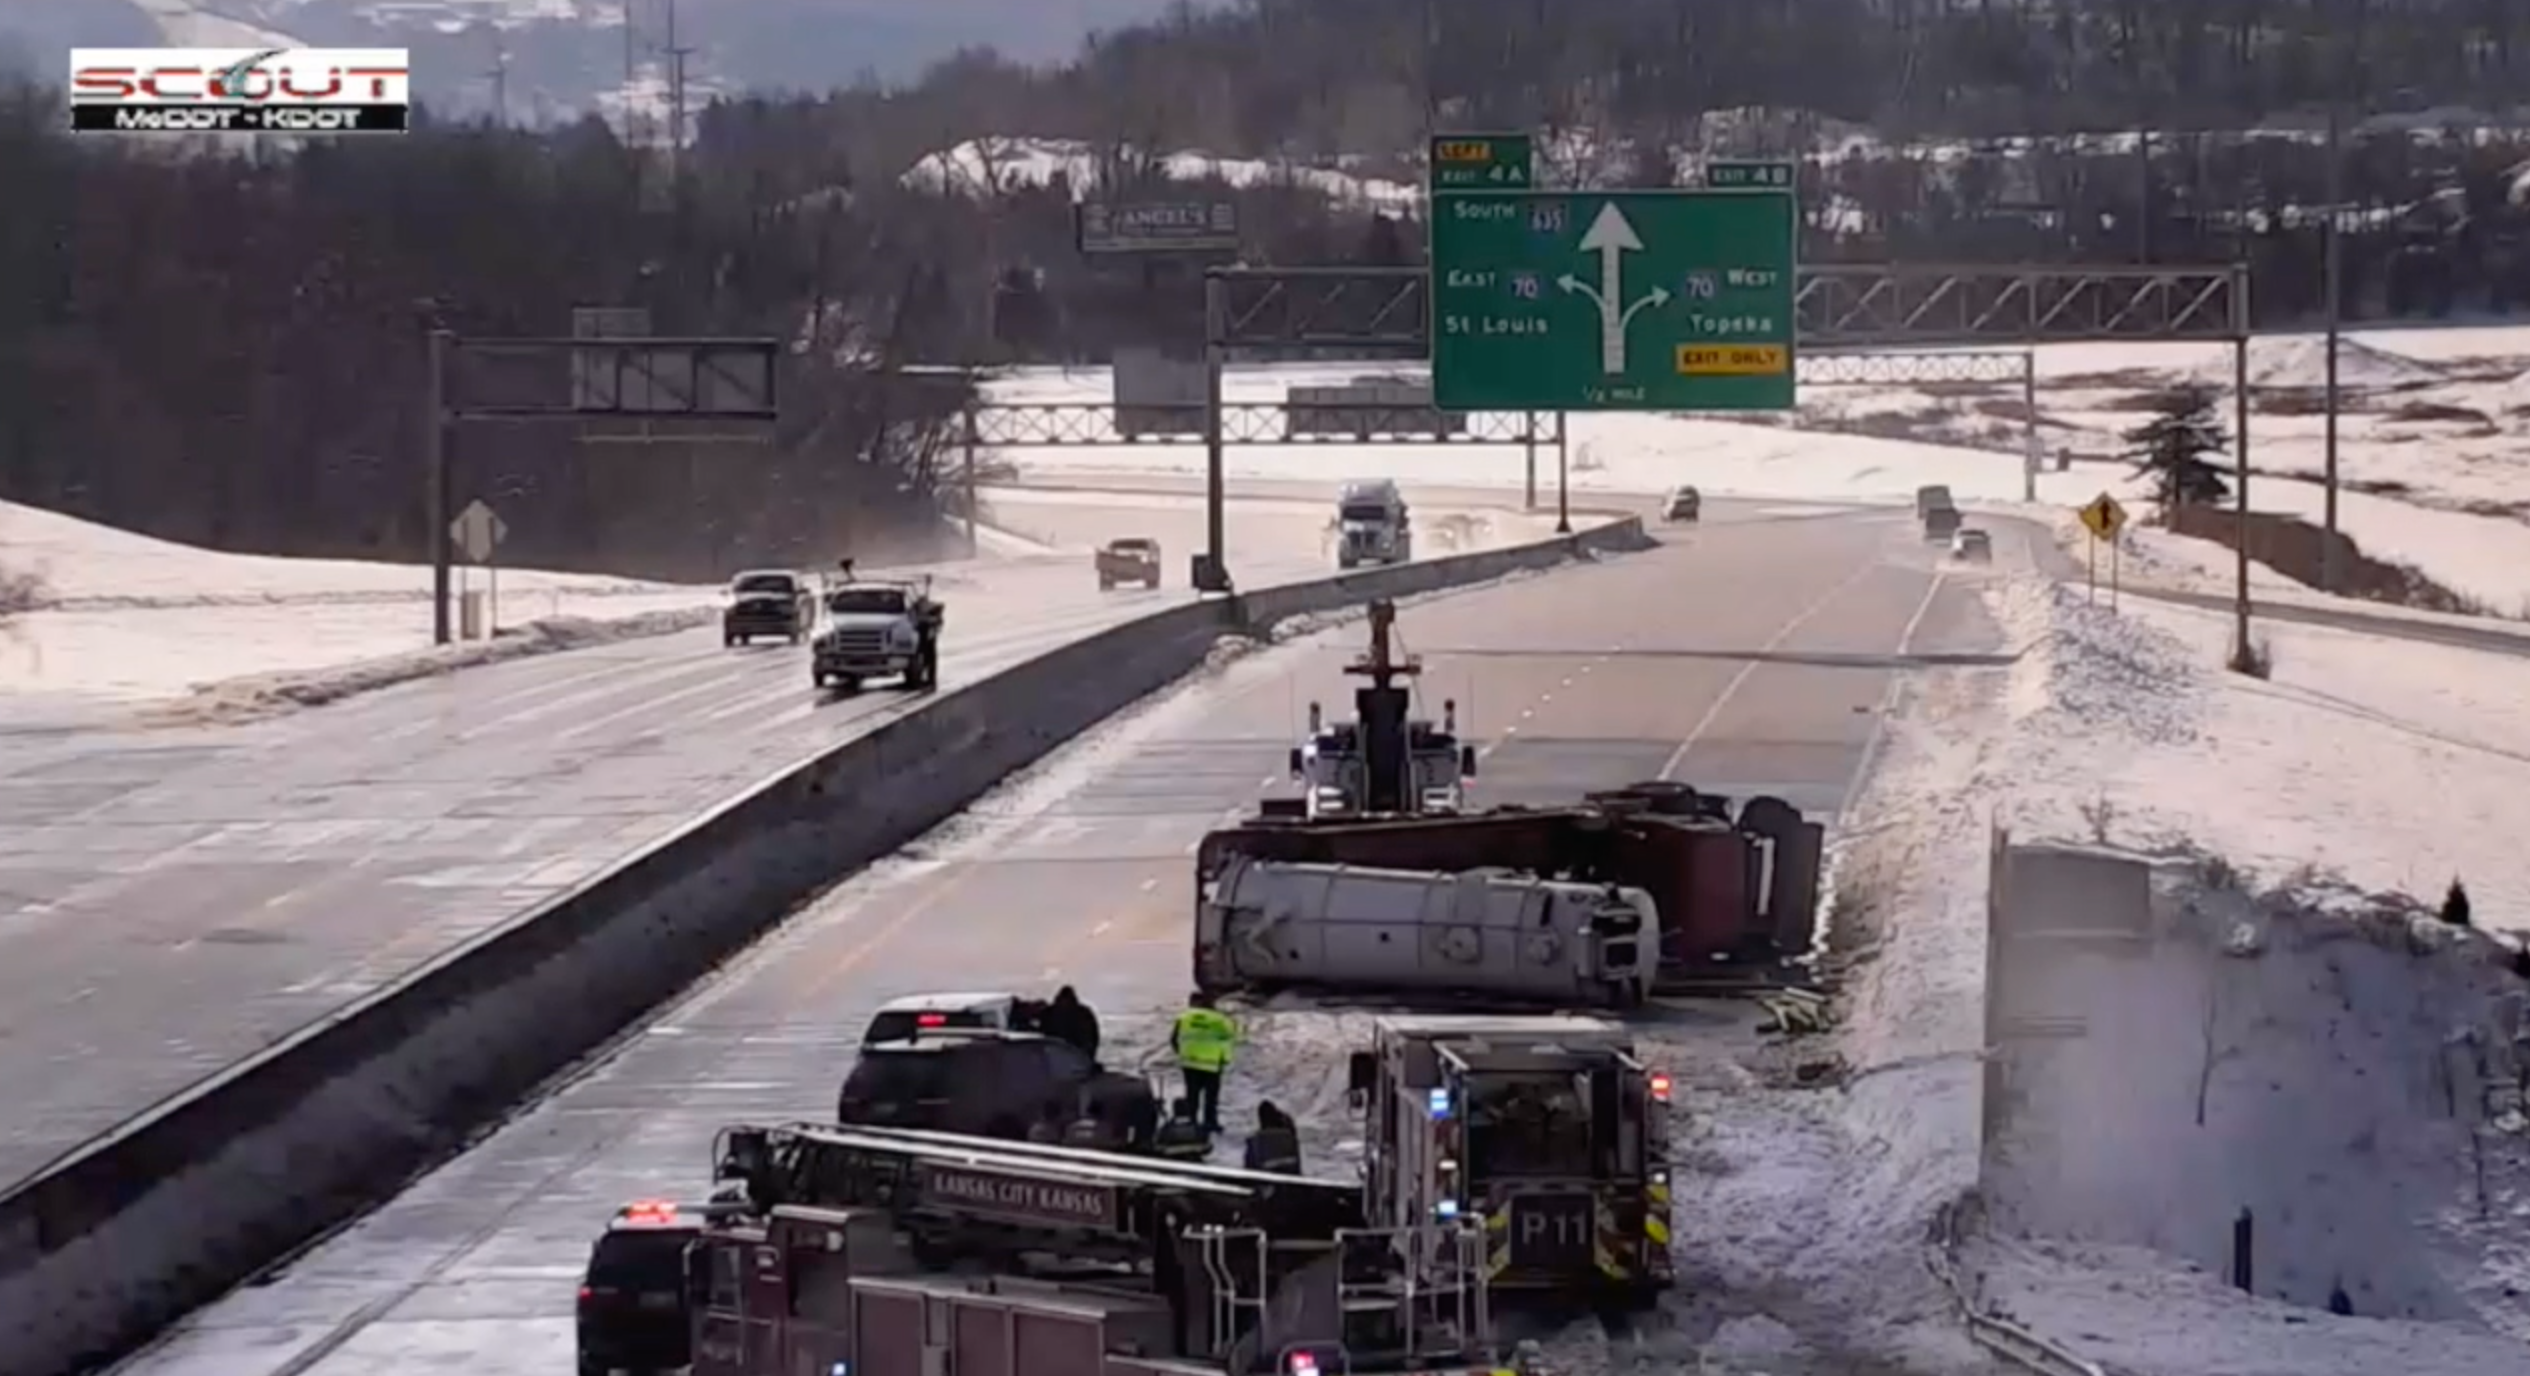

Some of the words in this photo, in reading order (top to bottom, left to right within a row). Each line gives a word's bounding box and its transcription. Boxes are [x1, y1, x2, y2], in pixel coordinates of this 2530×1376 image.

[1488, 166, 1524, 181] 4A
[1454, 201, 1515, 219] SOUTH
[1532, 209, 1562, 231] 635
[1447, 269, 1496, 287] EAST
[1727, 269, 1778, 286] WEST
[1512, 277, 1539, 298] 70
[1686, 276, 1715, 298] 70
[1445, 316, 1469, 334] St
[1482, 316, 1548, 334] Louis
[1690, 313, 1773, 334] Topeka
[1684, 351, 1719, 365] EXIT
[1732, 351, 1777, 365] ONLY
[934, 1172, 995, 1201] KANSAS
[1000, 1183, 1034, 1207] CITY
[1039, 1187, 1103, 1216] KANSAS
